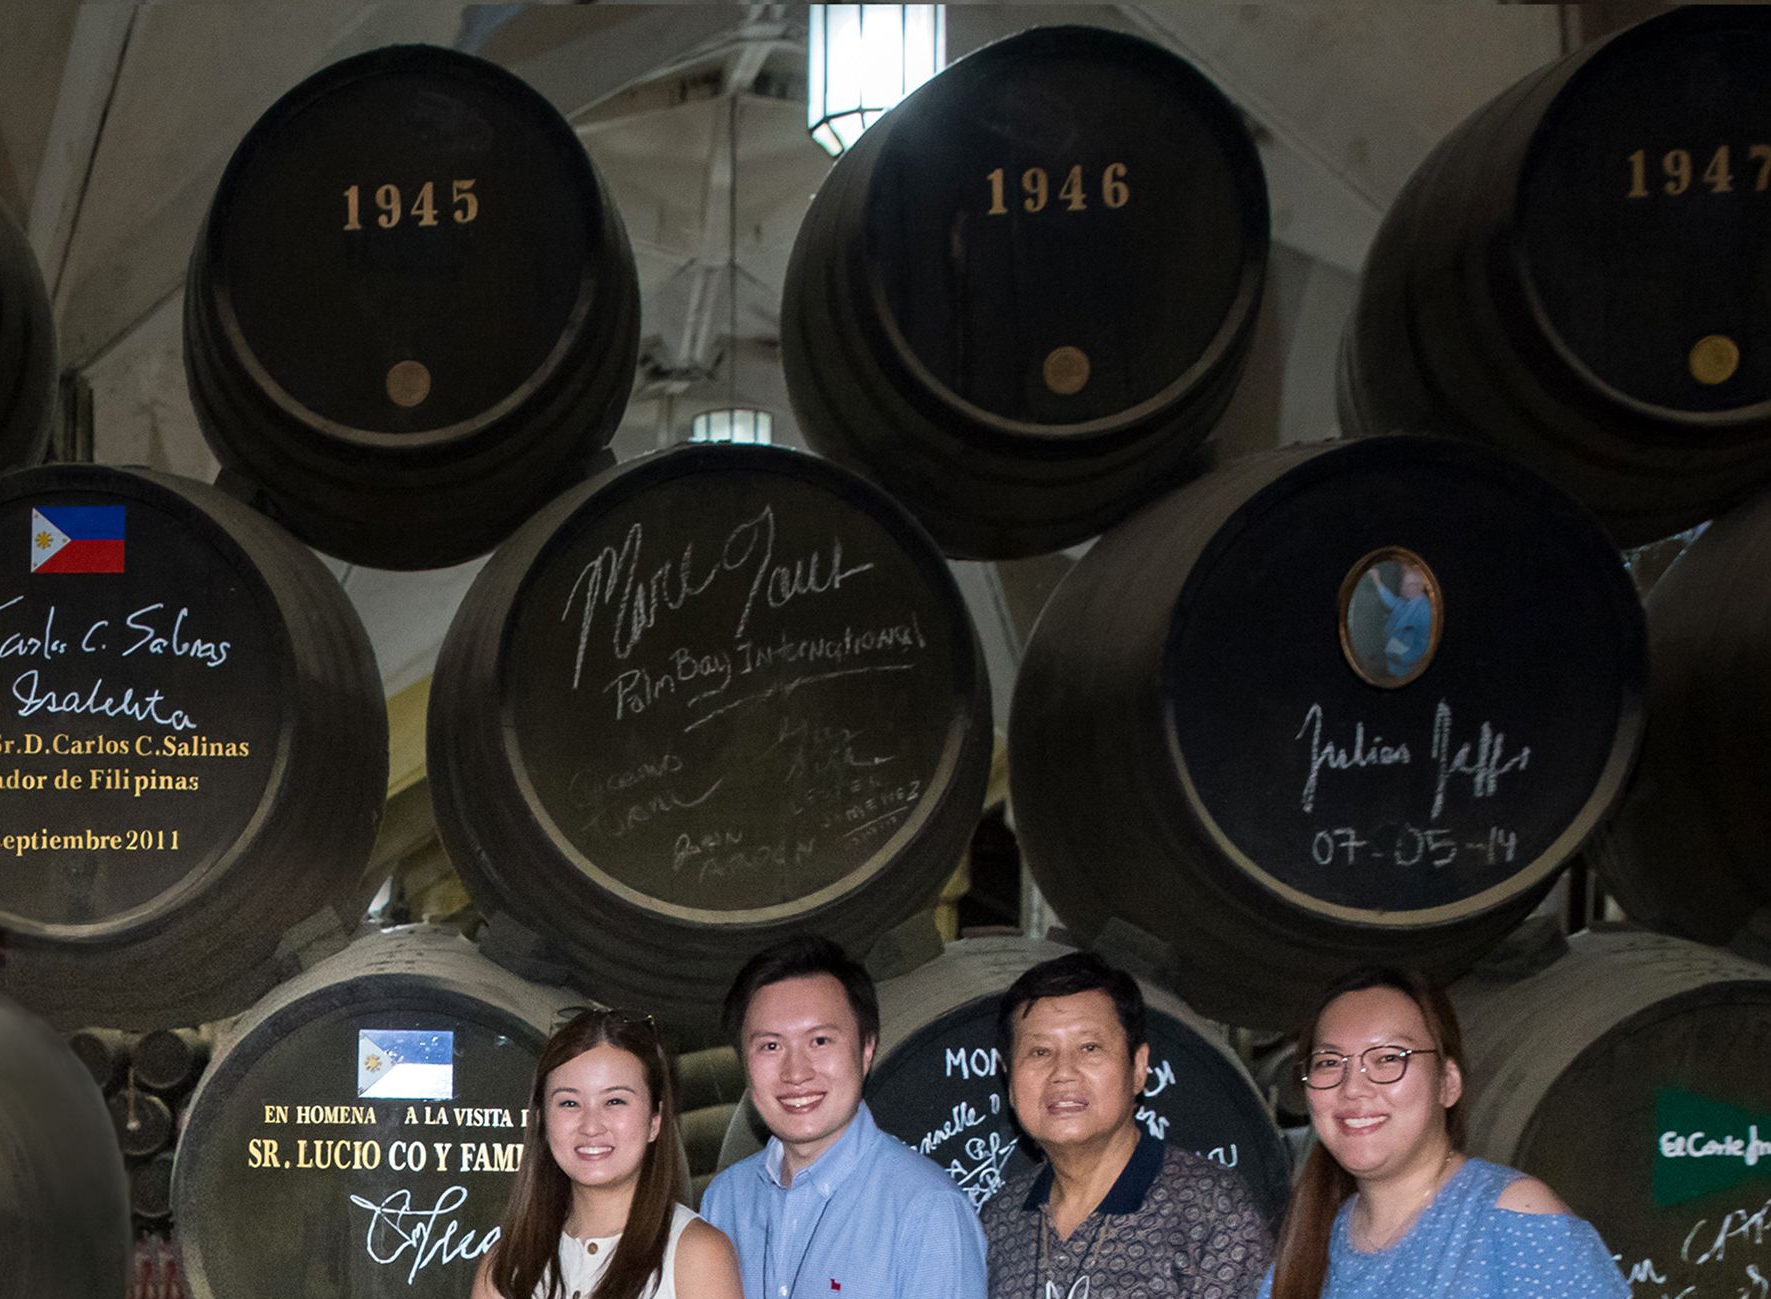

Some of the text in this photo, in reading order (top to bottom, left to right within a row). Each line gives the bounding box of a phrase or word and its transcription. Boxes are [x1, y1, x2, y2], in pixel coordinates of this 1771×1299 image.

[986, 162, 1131, 216] 1946
[1627, 144, 1771, 199] 1947
[343, 179, 480, 231] 1945
[53, 768, 83, 791] de
[89, 768, 200, 798] Filipinas
[264, 1105, 288, 1124] EN
[404, 1106, 418, 1125] A
[424, 1106, 449, 1125] LA
[453, 1108, 514, 1128] VISITA
[248, 1139, 290, 1169] SR.
[297, 1140, 381, 1170] LUCIO
[389, 1141, 426, 1171] CO
[433, 1142, 452, 1171] Y
